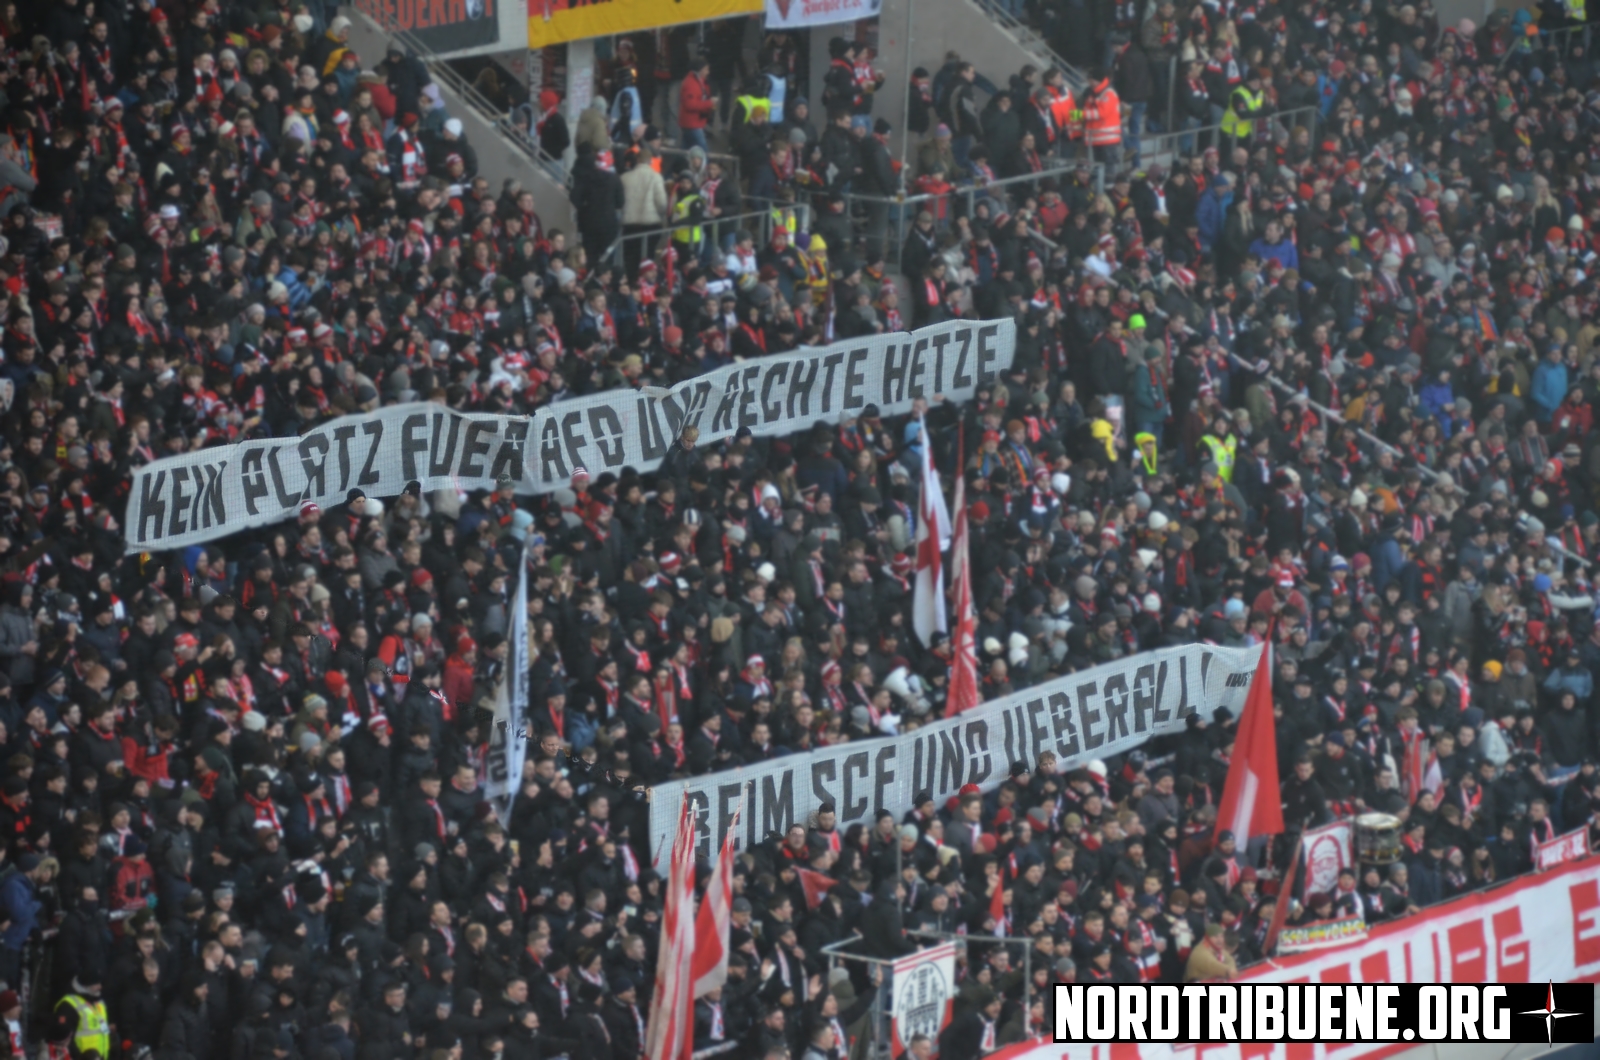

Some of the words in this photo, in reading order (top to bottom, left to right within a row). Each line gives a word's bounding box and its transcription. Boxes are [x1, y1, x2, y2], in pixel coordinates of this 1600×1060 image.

[137, 461, 227, 542] KEIN
[241, 419, 383, 515] PLATZ
[402, 413, 530, 481] FUER
[540, 405, 626, 482] AFD
[711, 348, 869, 434] RECHTE
[884, 325, 998, 402] HETZE
[811, 744, 898, 824] SCF
[912, 718, 993, 806] UND
